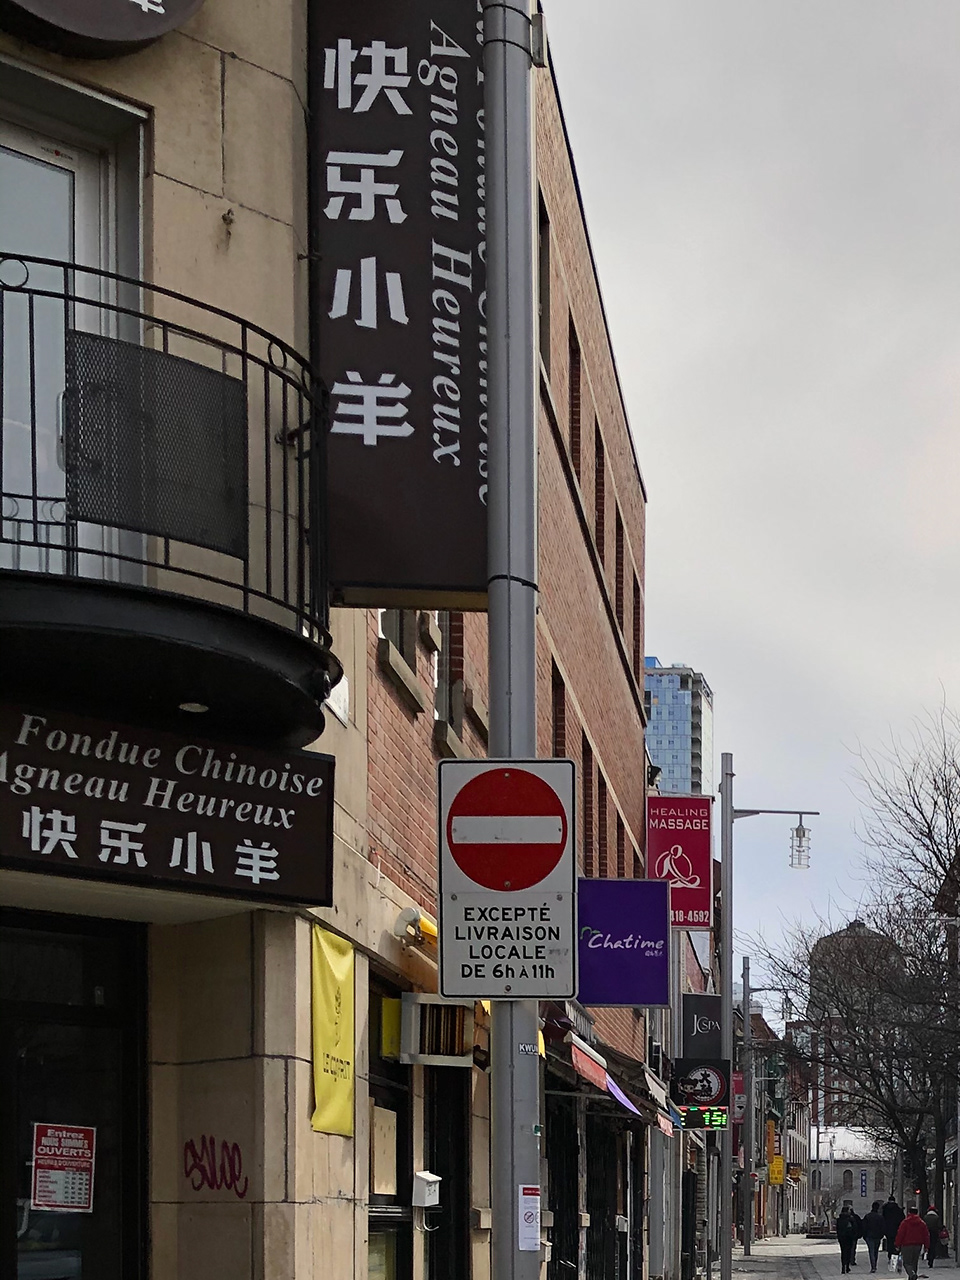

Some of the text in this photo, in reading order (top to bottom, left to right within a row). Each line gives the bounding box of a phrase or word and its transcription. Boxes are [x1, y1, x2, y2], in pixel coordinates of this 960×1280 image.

[323, 38, 415, 446] 快乐小羊
[417, 19, 473, 467] Agneau Heureux
[14, 713, 324, 797] Fondue Chinoise
[143, 777, 296, 830] Heureux
[650, 808, 708, 817] HEALING
[649, 819, 709, 830] MASSAGE
[22, 805, 281, 885] 快乐小羊
[463, 903, 551, 922] EXCEPTÉ
[455, 926, 560, 941] LIVRAISON
[588, 934, 665, 950] Chatime
[469, 945, 546, 960] LOCALE
[461, 963, 555, 979] DE 6h À 11h
[41, 1137, 59, 1147] NOUS
[47, 1129, 84, 1139] Entrez
[37, 1146, 92, 1158] OUVERTS
